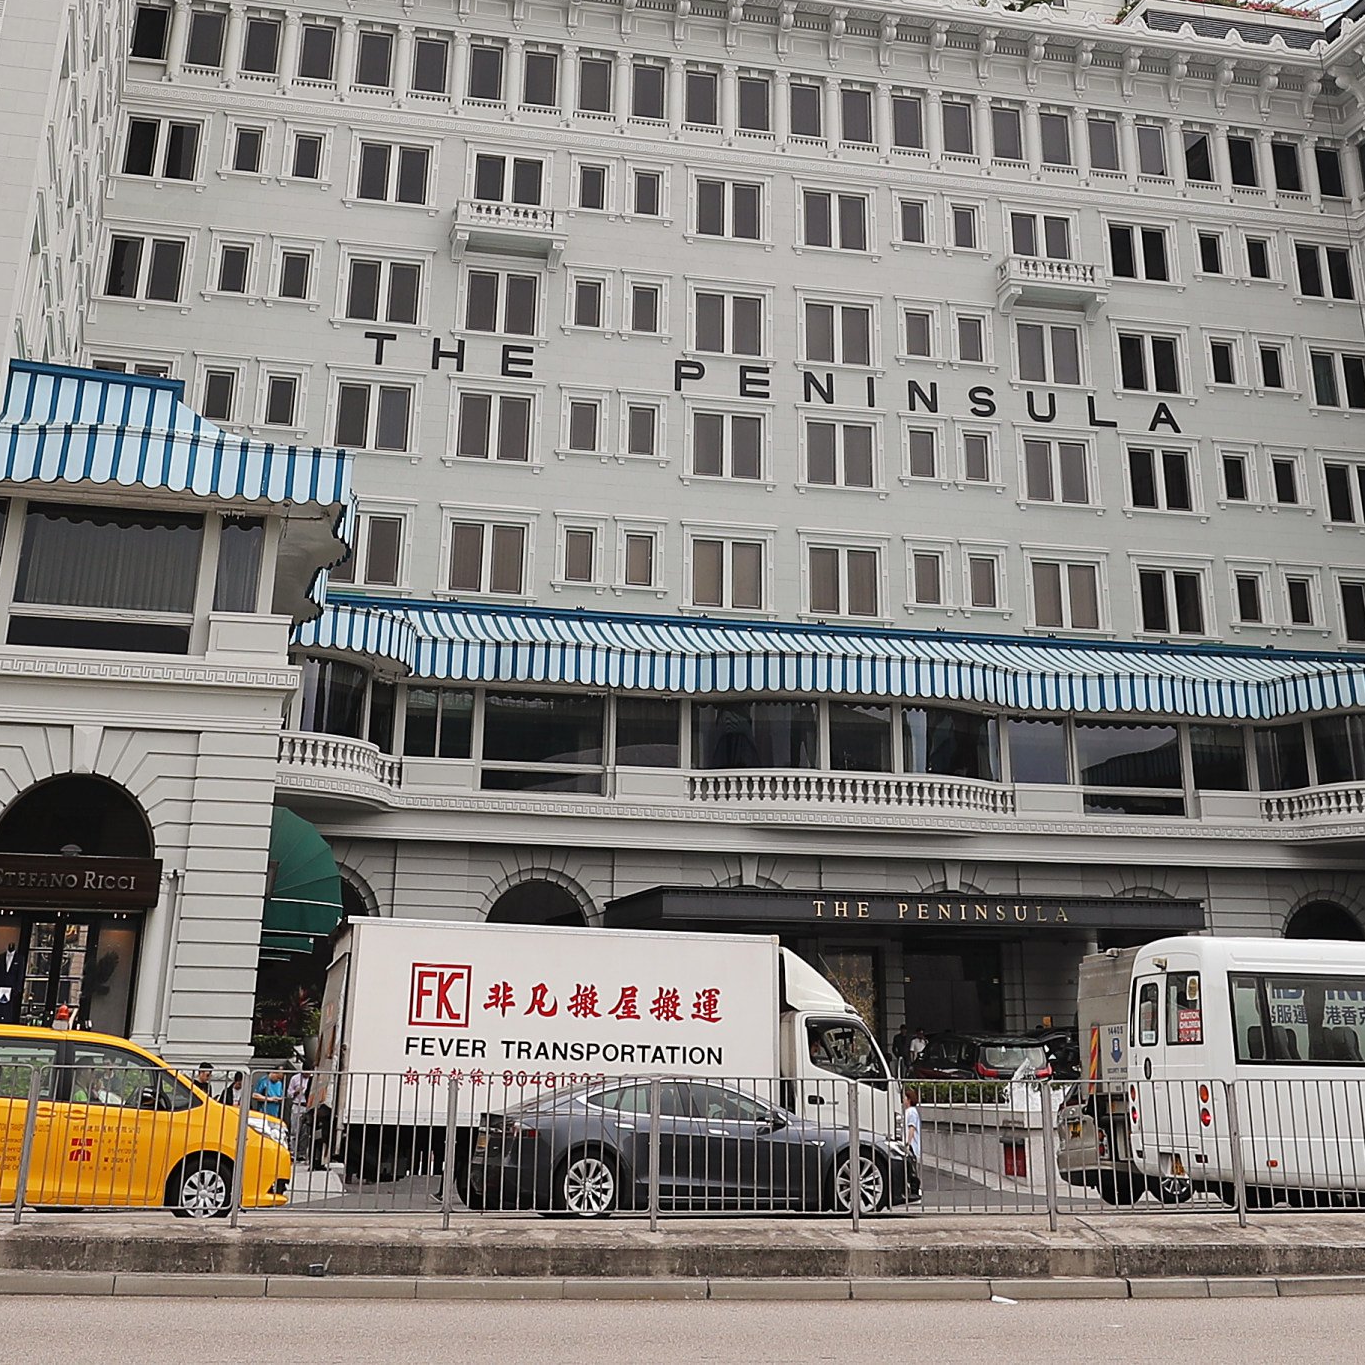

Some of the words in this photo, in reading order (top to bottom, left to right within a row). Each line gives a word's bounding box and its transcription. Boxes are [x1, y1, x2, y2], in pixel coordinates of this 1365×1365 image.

[364, 331, 534, 378] THE
[674, 359, 1182, 434] PENINSULA
[813, 900, 870, 918] THE
[898, 902, 1069, 922] PENINSULA
[415, 970, 464, 1020] FK
[483, 981, 723, 1023] 非凡搬屋搬運
[405, 1037, 486, 1058] FEVER
[501, 1040, 723, 1065] TRANSPORTATION
